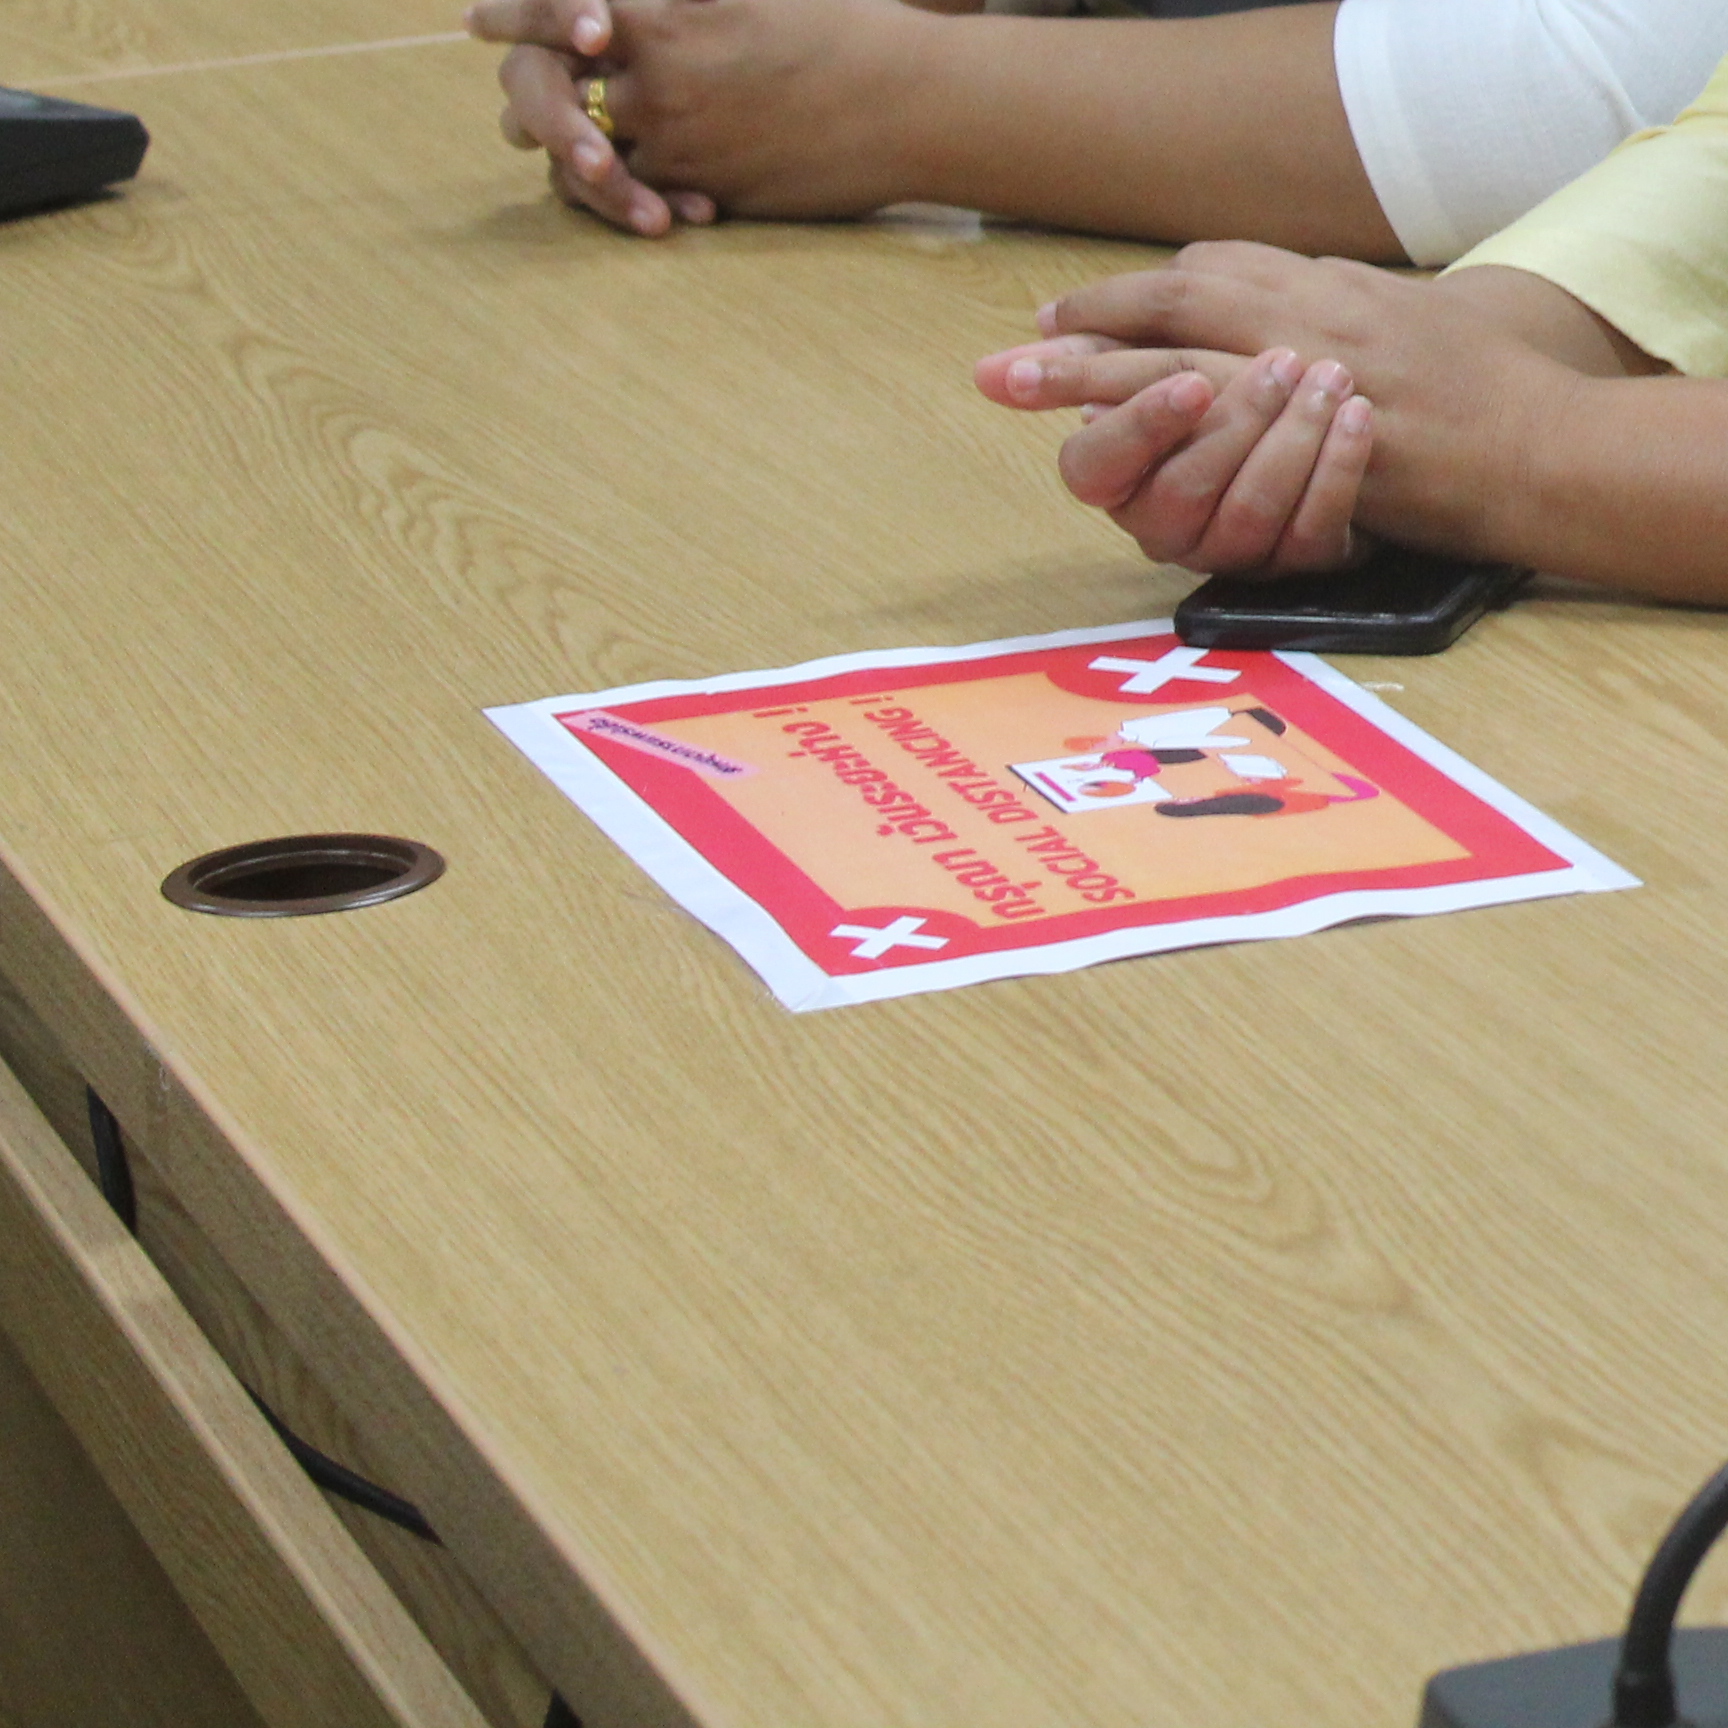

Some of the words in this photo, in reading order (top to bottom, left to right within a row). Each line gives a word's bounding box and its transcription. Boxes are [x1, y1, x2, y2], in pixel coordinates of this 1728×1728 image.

[863, 707, 1039, 823] DISTANCING
[932, 848, 1045, 919] กรุณา
[1014, 825, 1135, 903] SOCIAL
